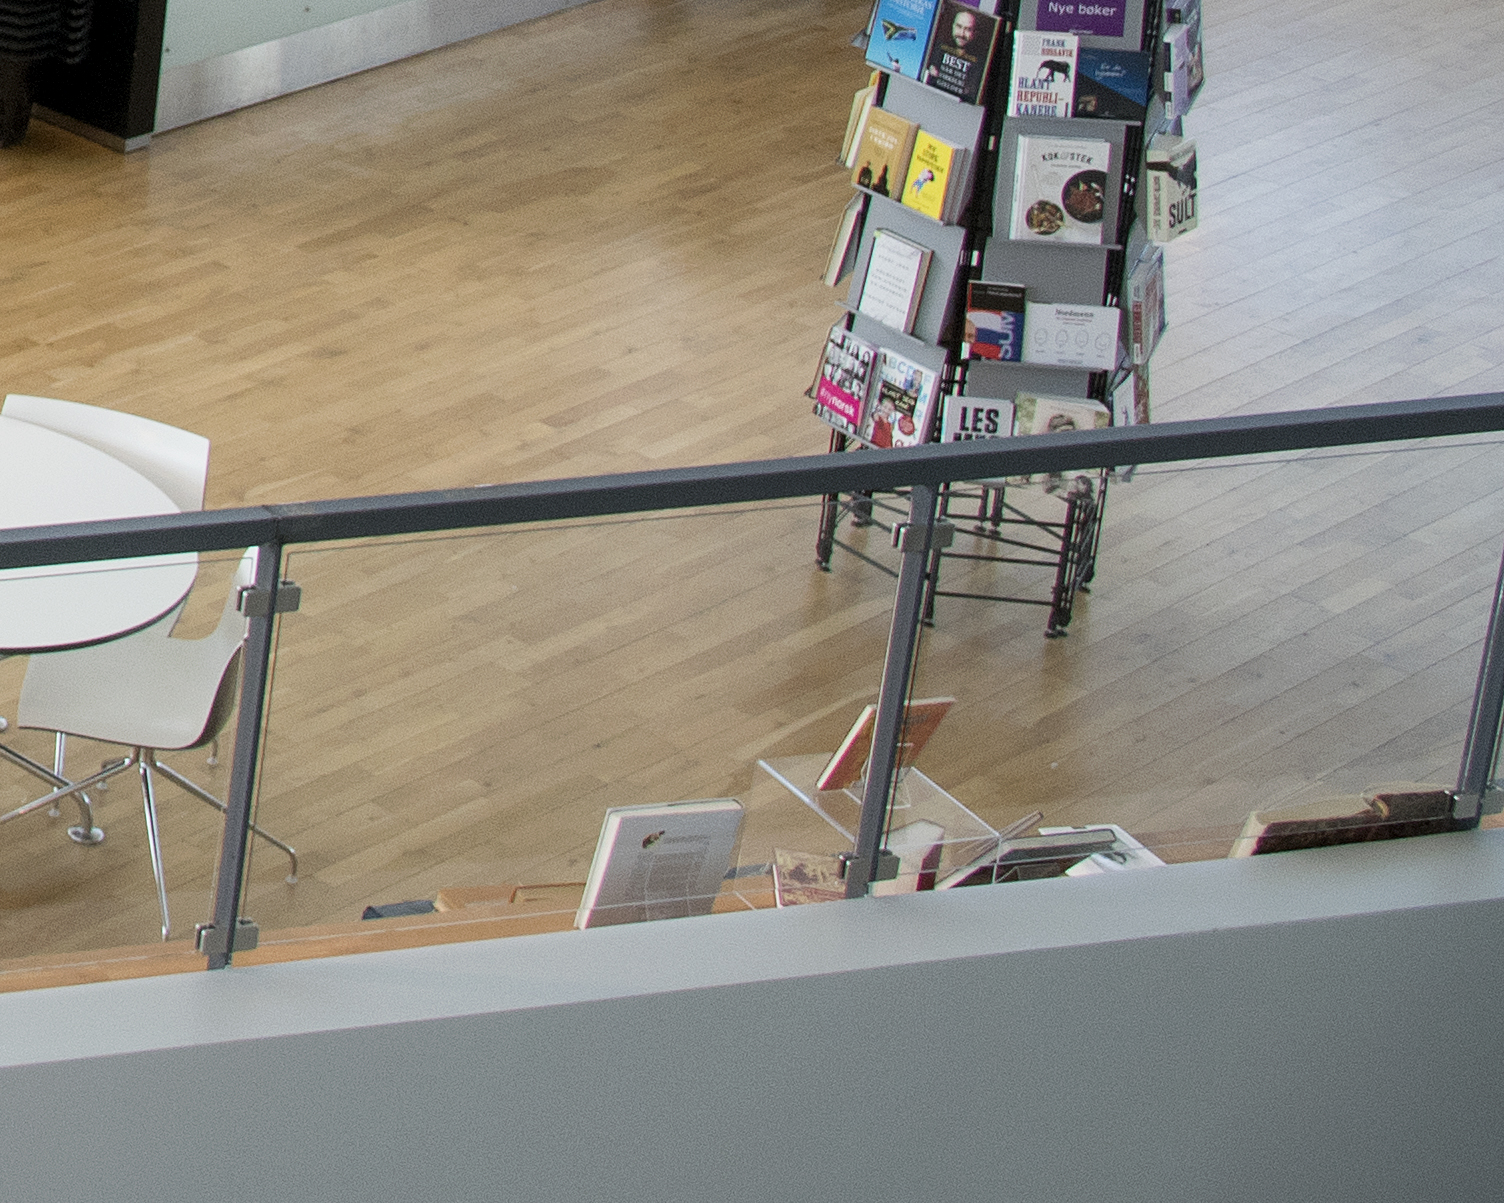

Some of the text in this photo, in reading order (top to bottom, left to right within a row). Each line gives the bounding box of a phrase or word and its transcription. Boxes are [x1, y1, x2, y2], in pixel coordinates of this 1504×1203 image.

[1048, 0, 1118, 18] Nye bøker
[941, 52, 971, 73] BEST
[1169, 192, 1197, 230] SULT
[958, 406, 1000, 434] LES
